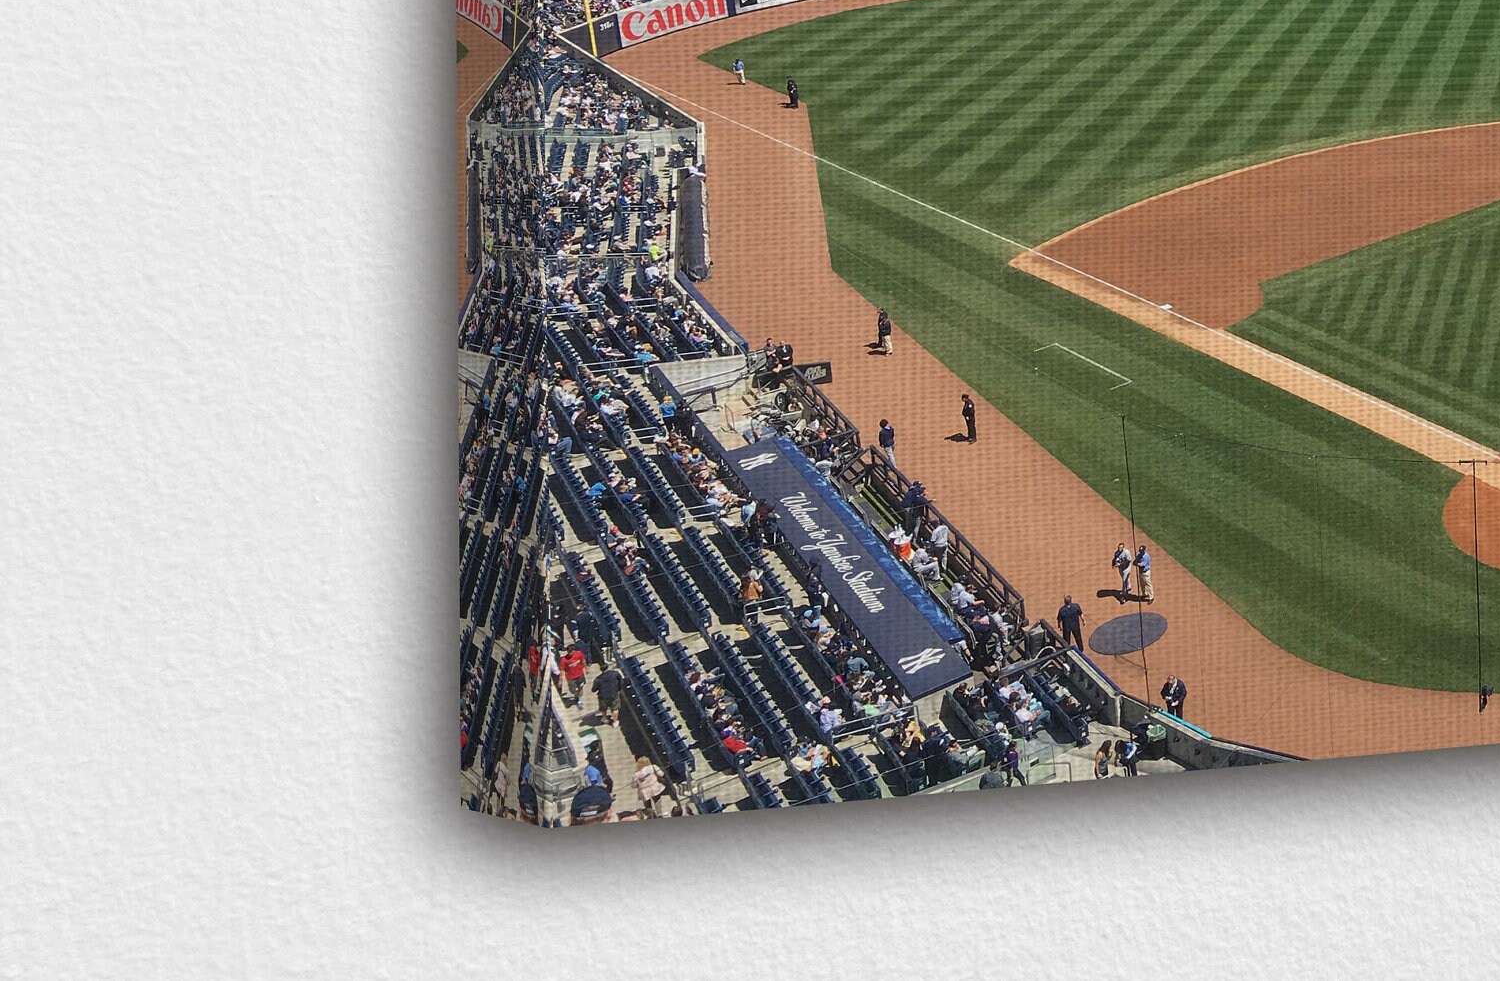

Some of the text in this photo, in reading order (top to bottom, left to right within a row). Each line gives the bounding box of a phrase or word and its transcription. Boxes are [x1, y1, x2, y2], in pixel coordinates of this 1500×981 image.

[780, 491, 885, 613] Welcome to Yankee Stadium
